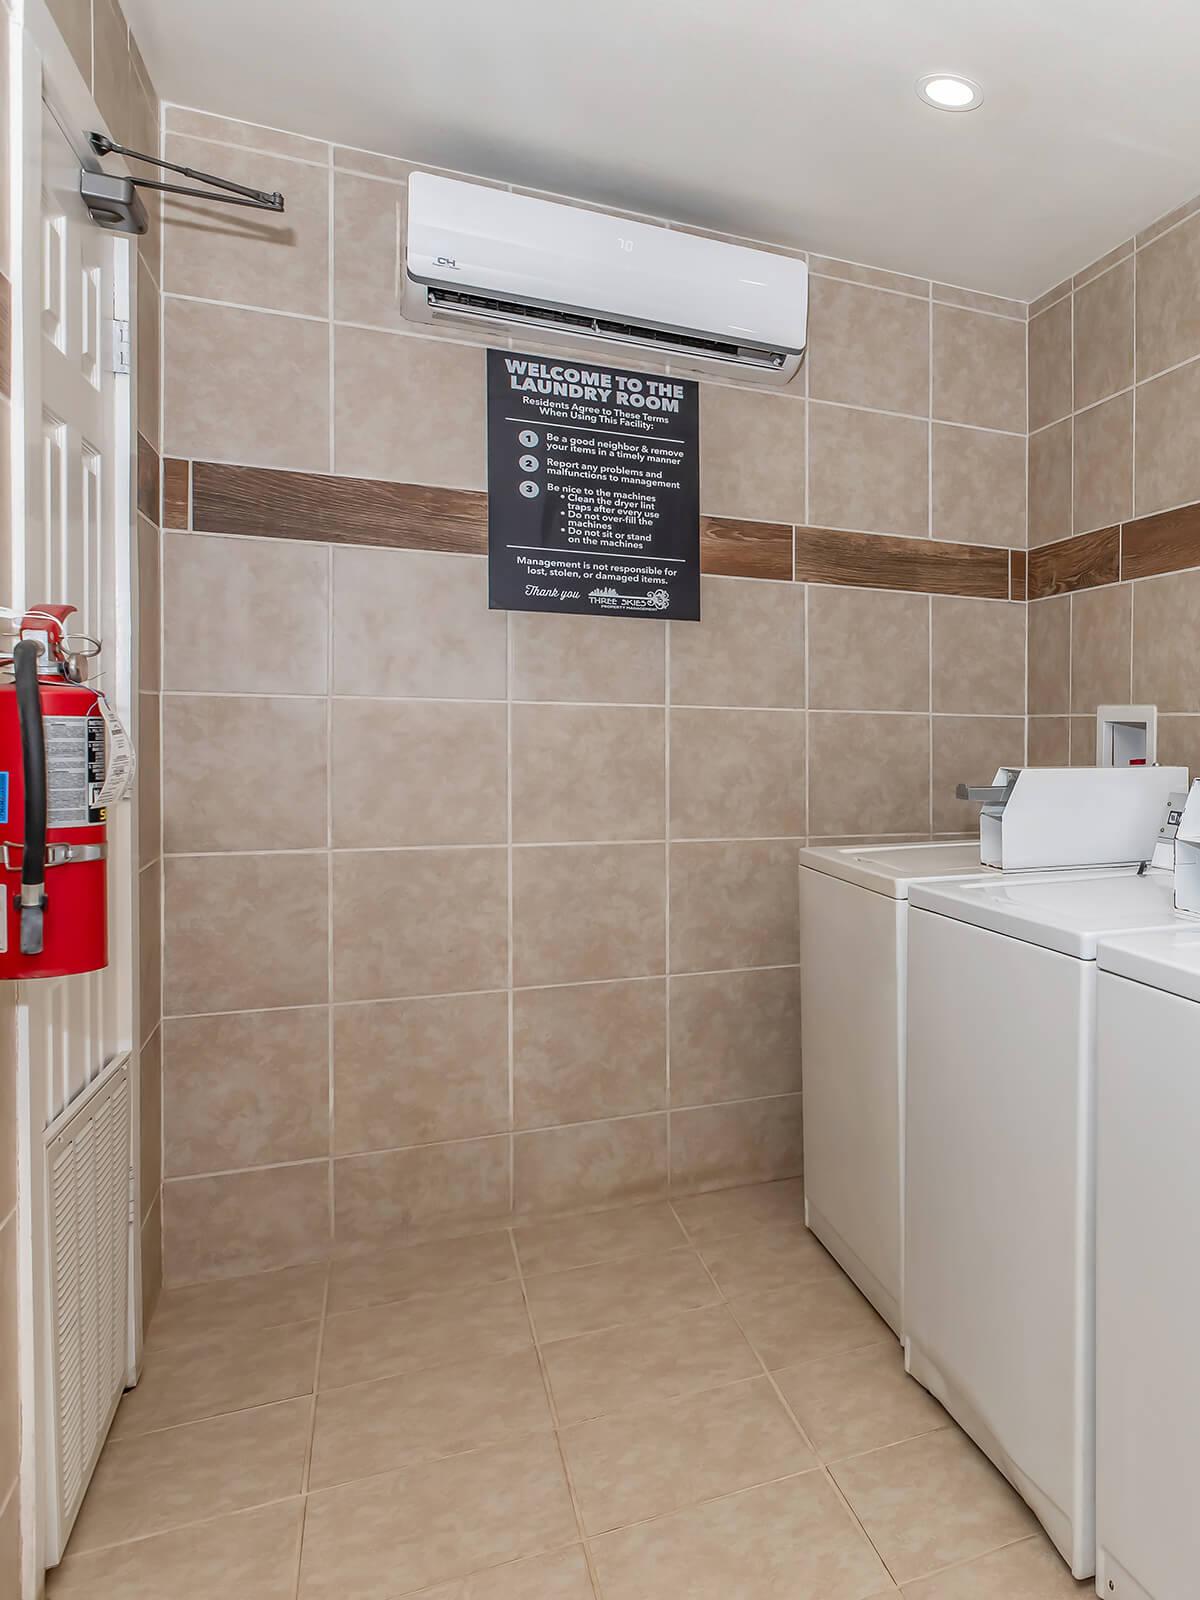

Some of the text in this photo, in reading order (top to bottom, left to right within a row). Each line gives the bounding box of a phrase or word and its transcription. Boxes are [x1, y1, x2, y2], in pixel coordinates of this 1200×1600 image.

[504, 358, 684, 399] WELCOME TO THE
[510, 374, 679, 413] LAUNDRY ROOM
[522, 395, 669, 424] Residents Agree to These Terms
[539, 406, 654, 431] When Using This Facility:
[546, 432, 560, 442] Be
[569, 437, 595, 446] good
[597, 440, 640, 452] neighbor
[640, 445, 649, 454] &
[650, 448, 684, 458] remove
[546, 443, 569, 451] your
[570, 444, 596, 455] items
[598, 447, 607, 456] in
[616, 450, 645, 463] timely
[646, 455, 681, 465] manner
[546, 457, 662, 479] Report any problems and
[546, 468, 680, 489] malfunctions to management
[547, 483, 656, 502] Be nice to the machines
[567, 493, 655, 510] Clean the dryer lint
[567, 502, 660, 519] traps after every use
[568, 510, 653, 526] Do not over-fill the
[568, 520, 612, 530] machines
[568, 526, 582, 536] Do
[626, 533, 652, 542] stand
[582, 537, 598, 545] the
[600, 540, 643, 549] machines
[516, 556, 581, 569] Management
[583, 561, 591, 570] is
[610, 565, 663, 575] responsible
[664, 568, 677, 576] for
[527, 566, 547, 576] lost,
[549, 569, 581, 579] stolen,
[595, 571, 639, 583] damaged
[641, 575, 668, 584] items.
[524, 584, 581, 601] Thank you
[588, 596, 647, 607] THREE SKIES
